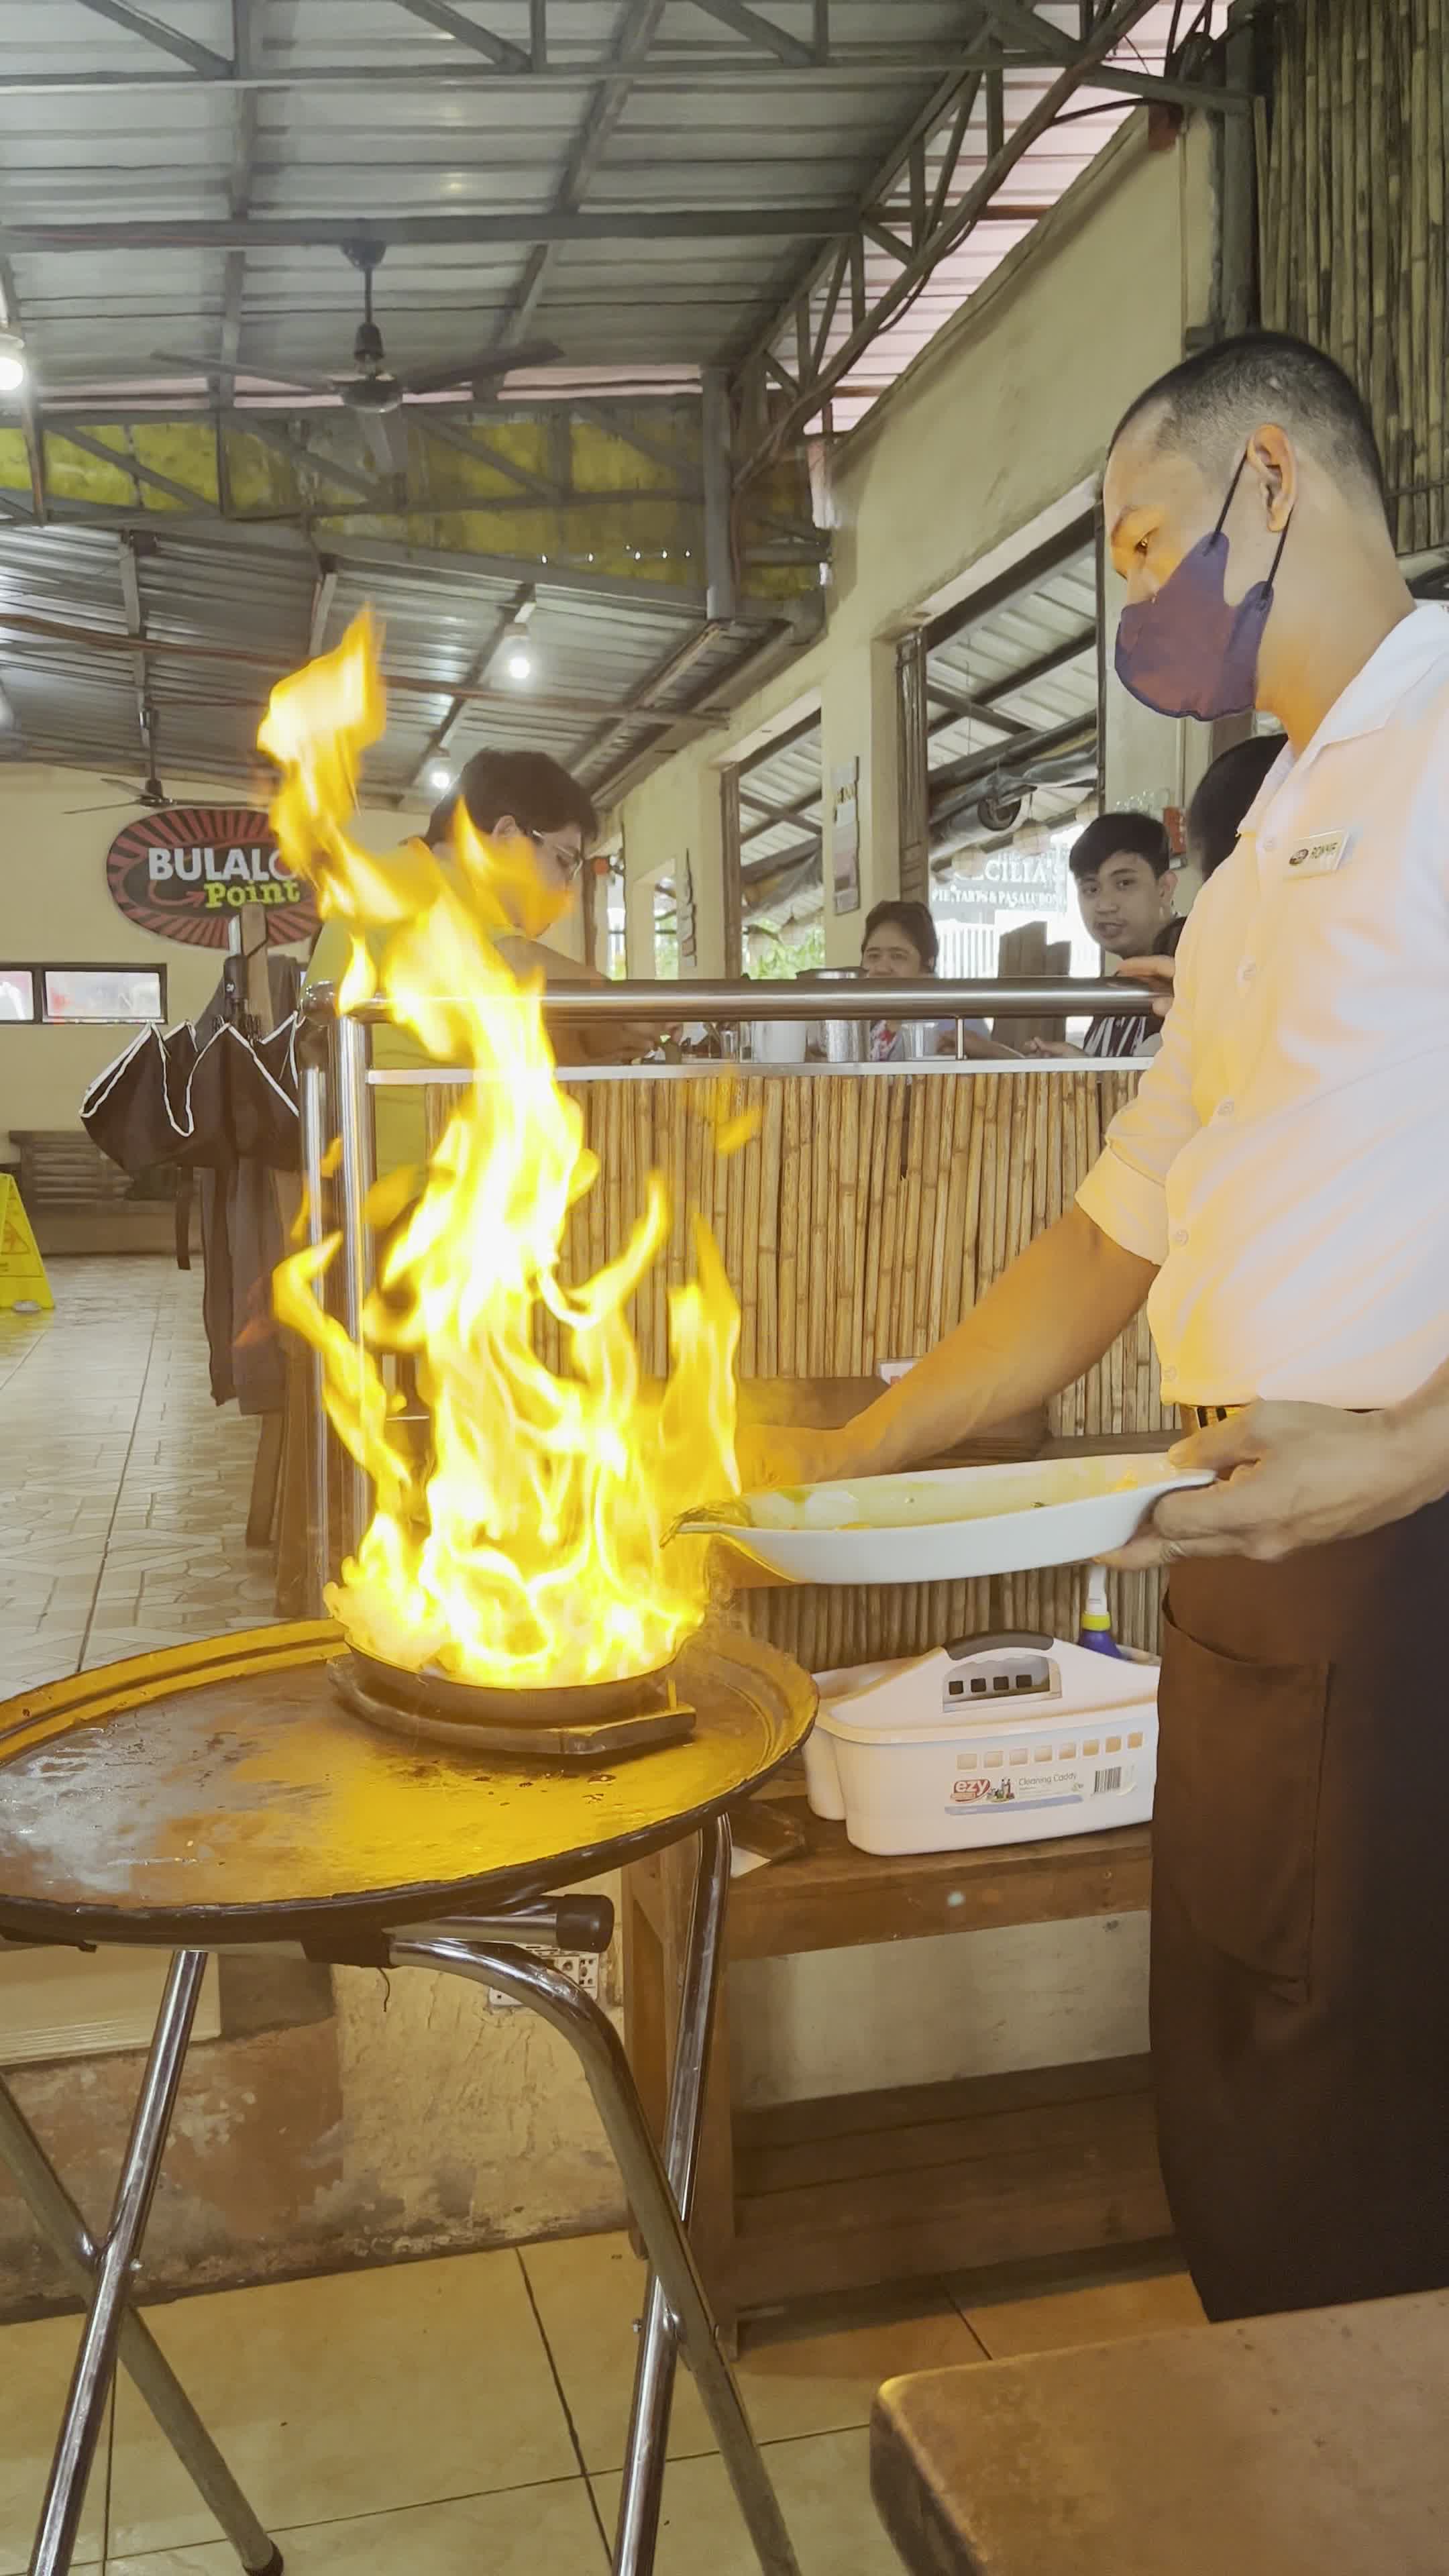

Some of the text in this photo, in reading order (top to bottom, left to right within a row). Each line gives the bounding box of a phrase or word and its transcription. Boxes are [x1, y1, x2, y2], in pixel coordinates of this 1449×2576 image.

[953, 858, 1066, 883] CILIA'S
[204, 879, 301, 908] Point
[955, 1779, 988, 1796] ezy
[1019, 1772, 1077, 1786] Cleaning Caddy
